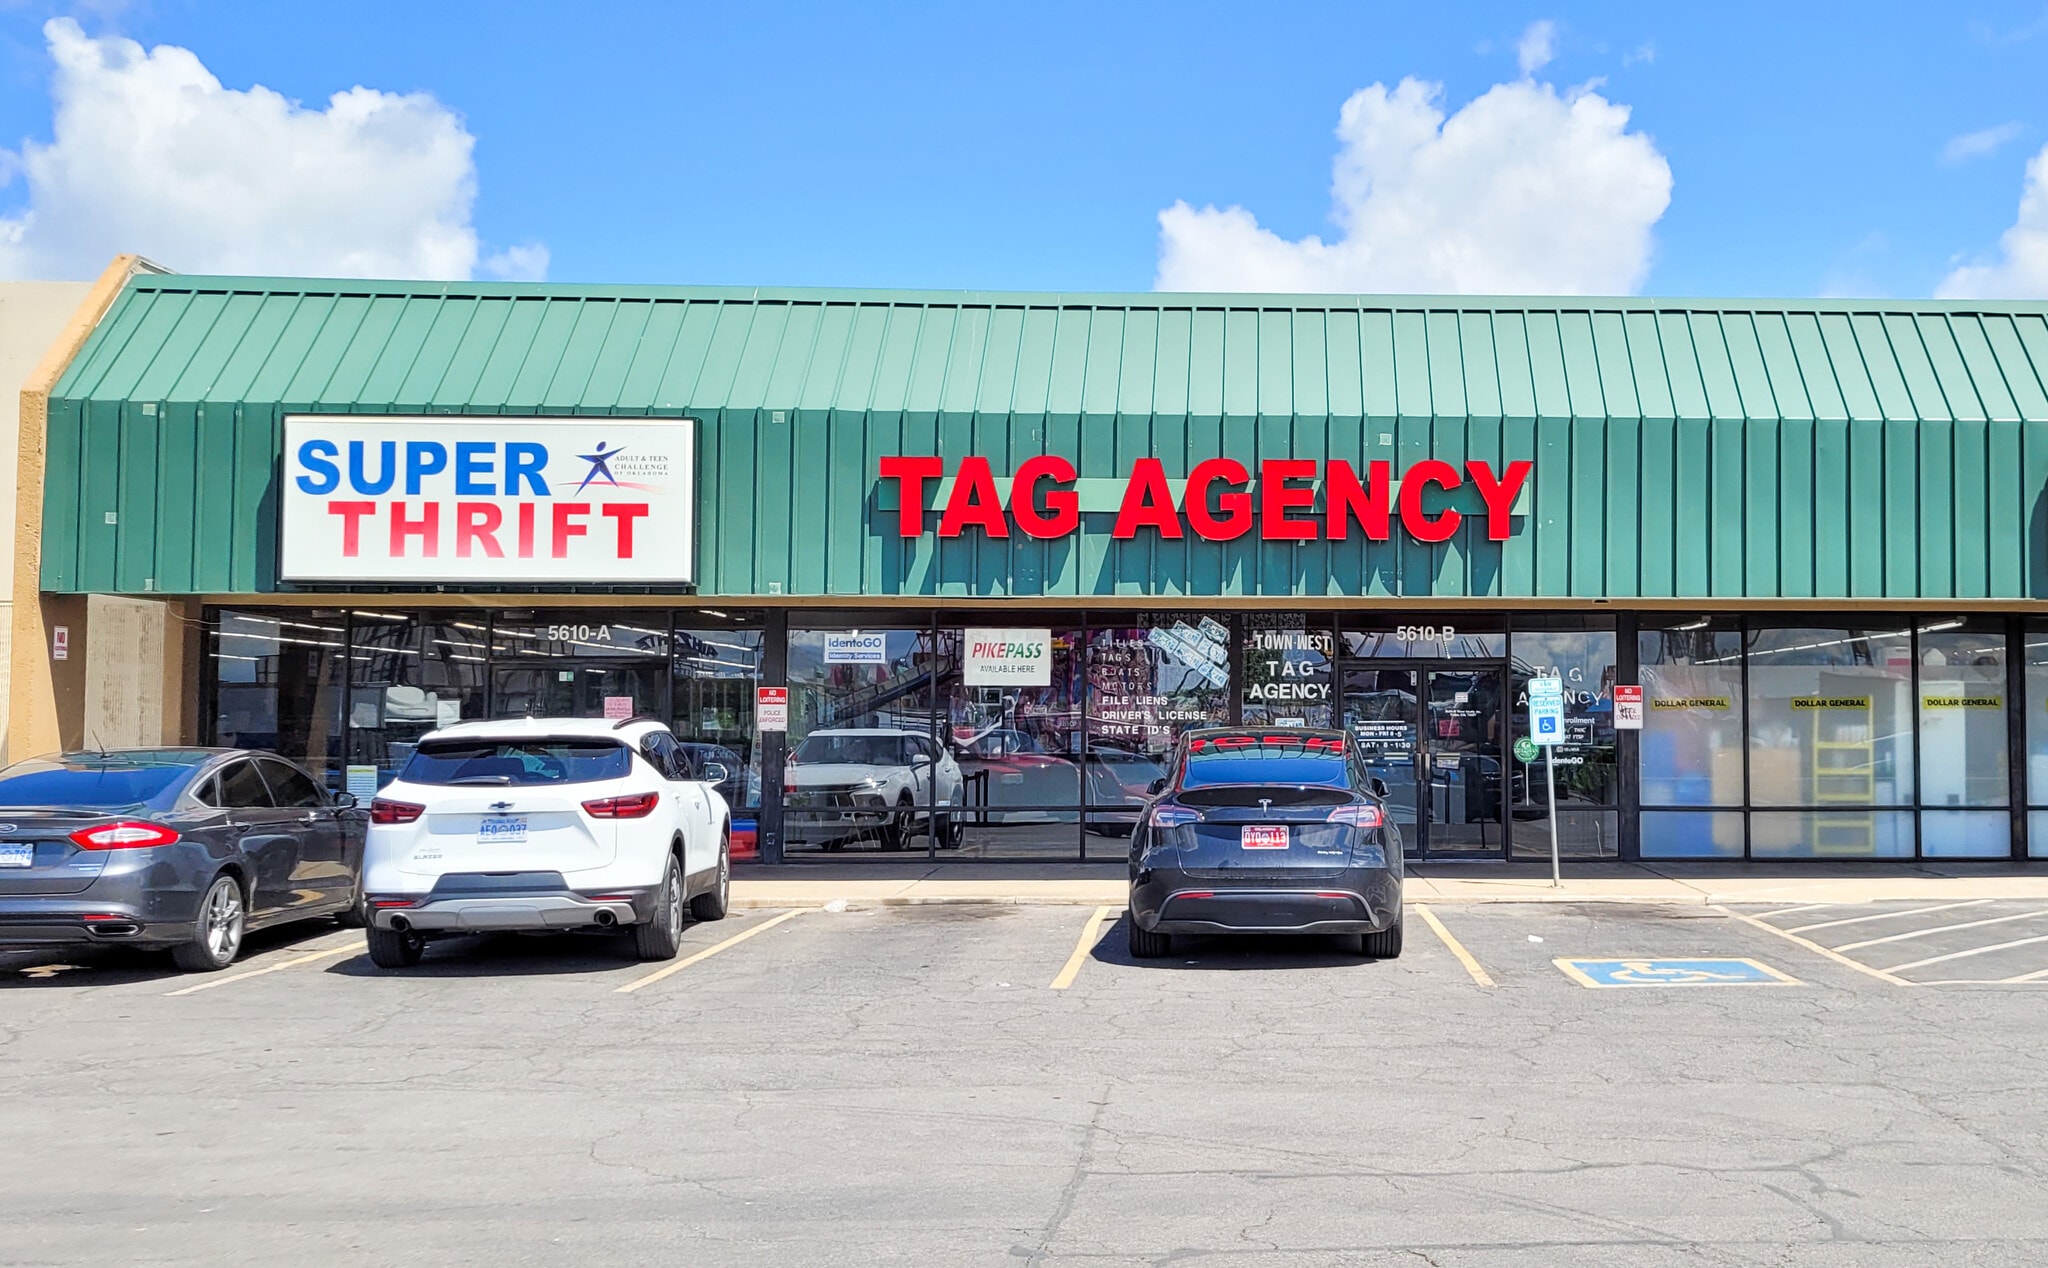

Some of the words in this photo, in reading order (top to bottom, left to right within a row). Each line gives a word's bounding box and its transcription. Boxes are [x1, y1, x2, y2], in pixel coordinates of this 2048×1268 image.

[295, 439, 552, 497] SUPER
[614, 463, 669, 471] CHALLENGE
[879, 455, 1080, 539] TAG
[1111, 457, 1534, 542] AGENCY
[328, 501, 649, 559] THRIFT
[547, 624, 612, 642] 5610-A
[1396, 626, 1456, 641] 5610-B
[972, 642, 1043, 659] PIKEPASS
[1102, 638, 1144, 648] TITLES
[1102, 652, 1132, 662] TAGS
[980, 664, 1016, 673] AVAILABLE
[1017, 664, 1036, 673] HERE
[1265, 660, 1314, 677] TAG
[1533, 666, 1583, 682] TAG
[1102, 681, 1153, 691] MOTORS
[1249, 683, 1331, 699] AGENCY
[1102, 696, 1129, 705] FILE
[1136, 696, 1169, 705] LIENS
[1516, 690, 1603, 706] ANCY
[1102, 711, 1151, 720] DRIVER'S
[1158, 711, 1208, 720] LICENSE
[1101, 725, 1140, 735] STATE
[1147, 725, 1171, 735] ID'S
[1552, 757, 1584, 765] dentoGO
